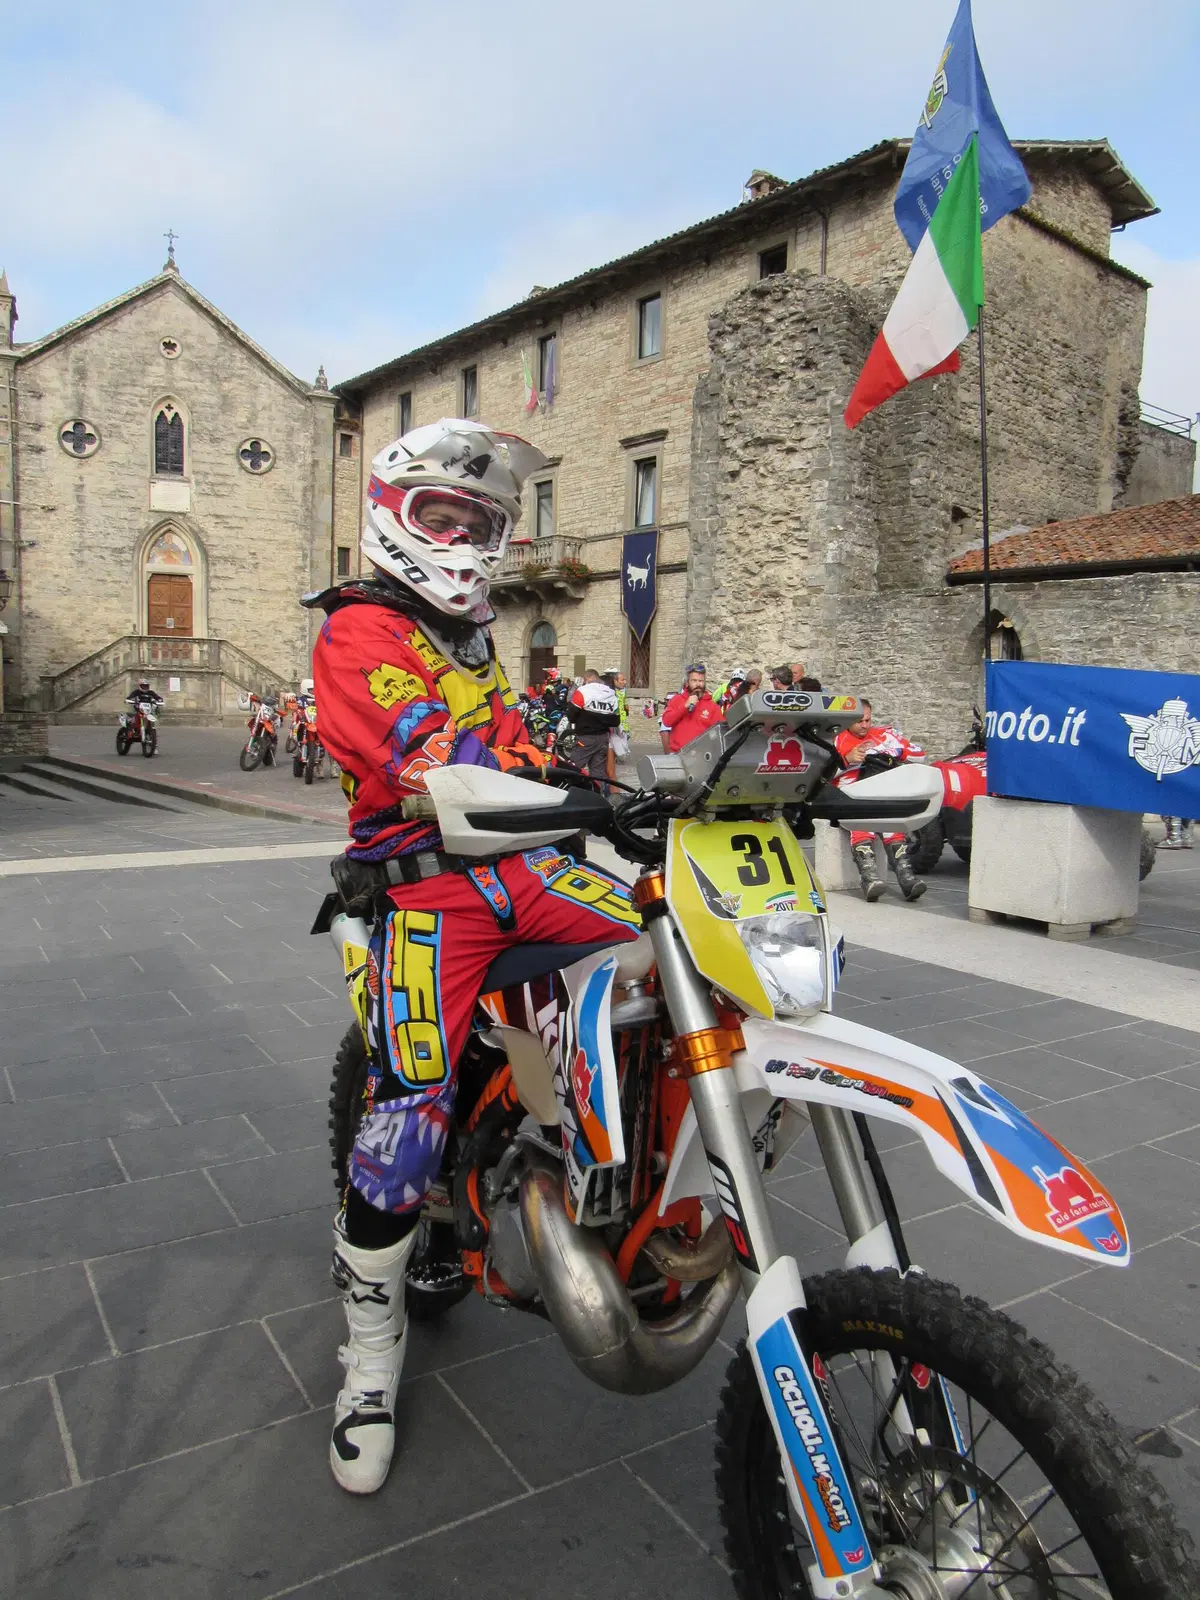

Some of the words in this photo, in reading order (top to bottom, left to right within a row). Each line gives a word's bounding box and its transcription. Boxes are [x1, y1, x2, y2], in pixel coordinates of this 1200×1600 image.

[378, 534, 430, 584] UFO
[763, 692, 813, 706] UFO
[731, 834, 795, 886] 31
[773, 901, 795, 912] 2017
[1056, 1211, 1070, 1224] old
[1069, 1204, 1089, 1217] farm
[1089, 1198, 1109, 1210] racing
[842, 1319, 904, 1340] MAXXIS
